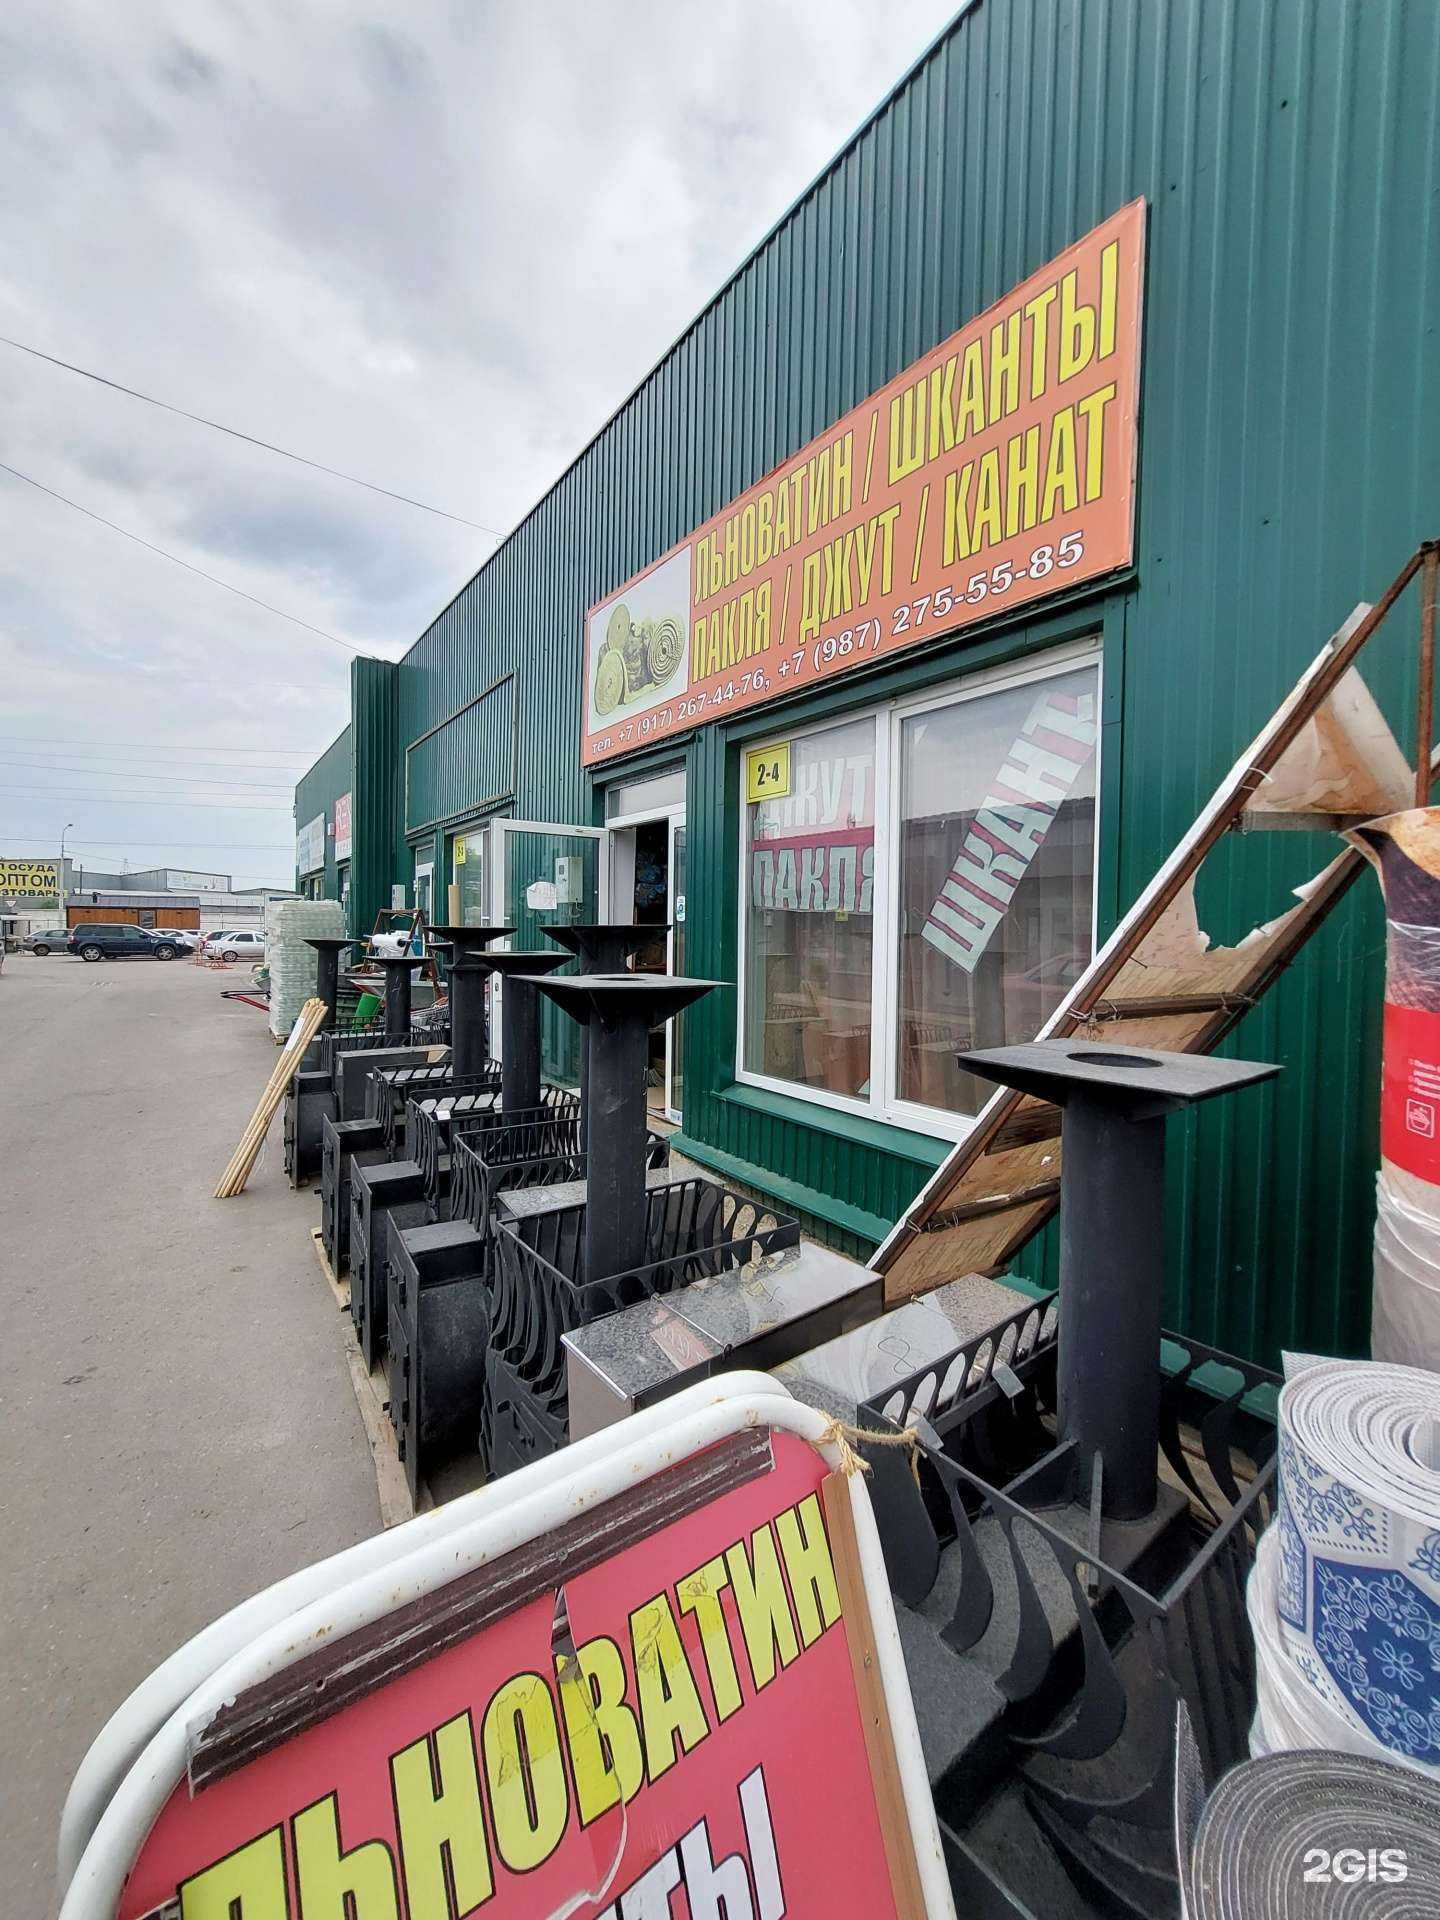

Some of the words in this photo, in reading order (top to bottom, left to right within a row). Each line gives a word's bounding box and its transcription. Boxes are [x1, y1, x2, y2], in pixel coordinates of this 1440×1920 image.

[692, 577, 773, 685] ПАКЛЯ
[798, 502, 901, 647] ДЖУТ
[942, 380, 1117, 569] КАНАТ
[694, 429, 853, 607] ЛЬНОВАТИН
[888, 240, 1119, 486] ШКАНТЫ
[592, 738, 614, 755] тел.
[618, 723, 634, 743] +7
[636, 707, 673, 739] (917)
[677, 667, 771, 721] 267-44-76,
[778, 650, 806, 678] +7
[812, 617, 882, 672] (987)
[891, 530, 1085, 636] 275-55-85
[757, 762, 780, 786] 2-4
